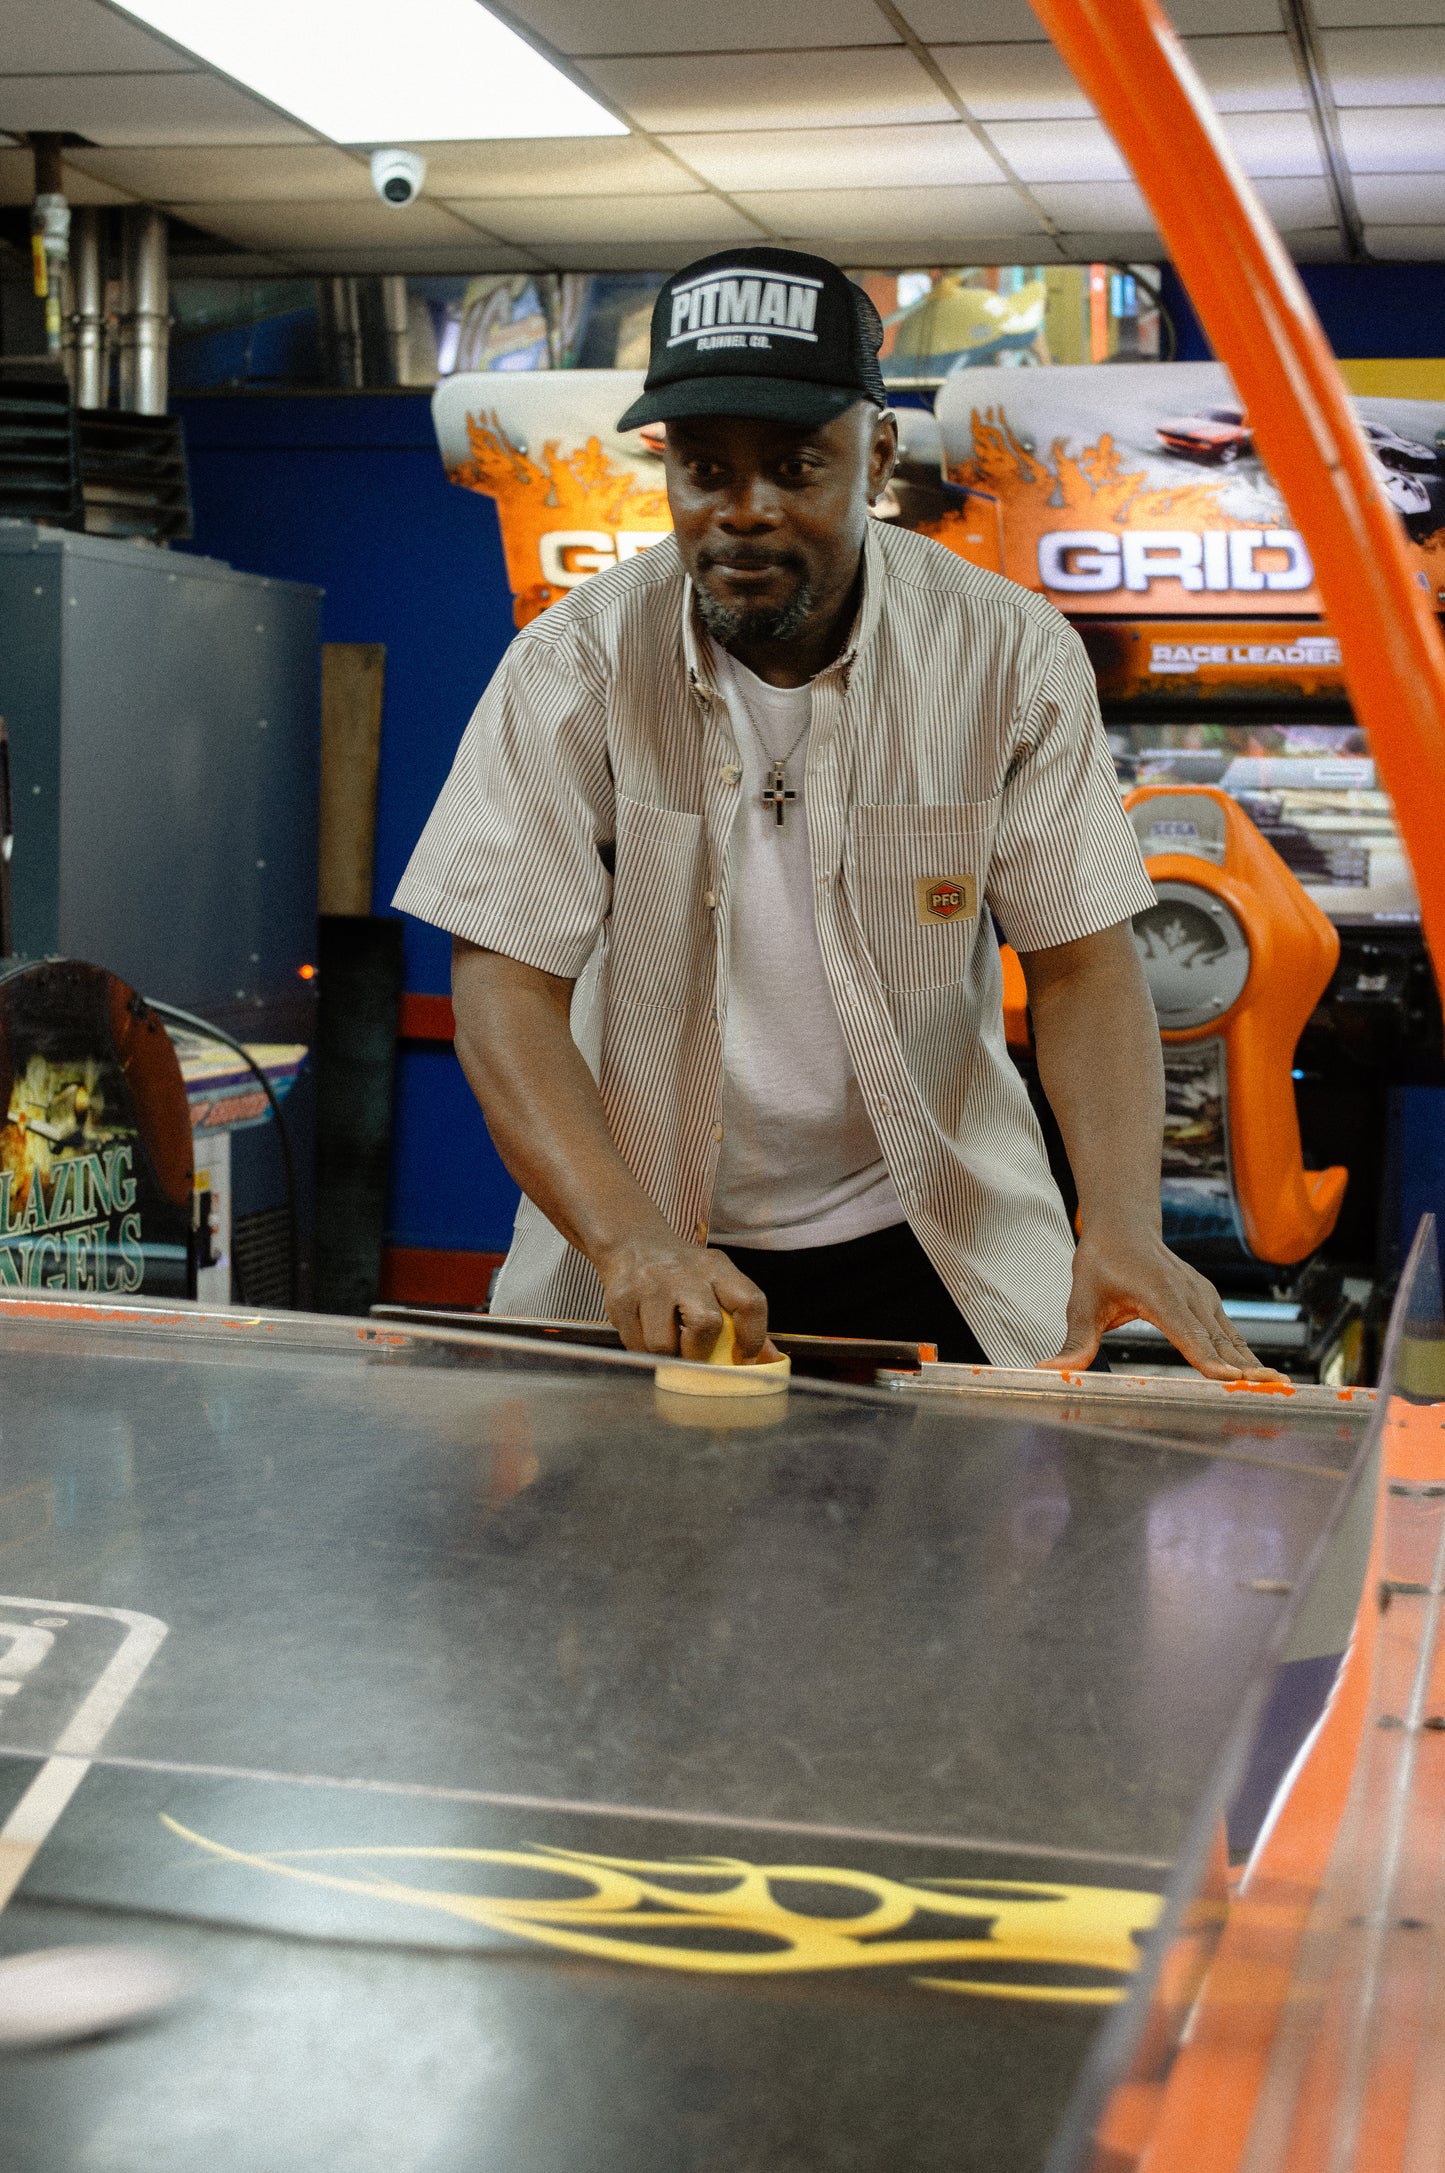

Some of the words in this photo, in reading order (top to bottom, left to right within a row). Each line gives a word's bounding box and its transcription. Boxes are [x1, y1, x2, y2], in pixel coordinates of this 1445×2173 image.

[670, 279, 818, 338] PITMAN
[1038, 530, 1314, 592] GRID
[1151, 645, 1229, 664] RACE
